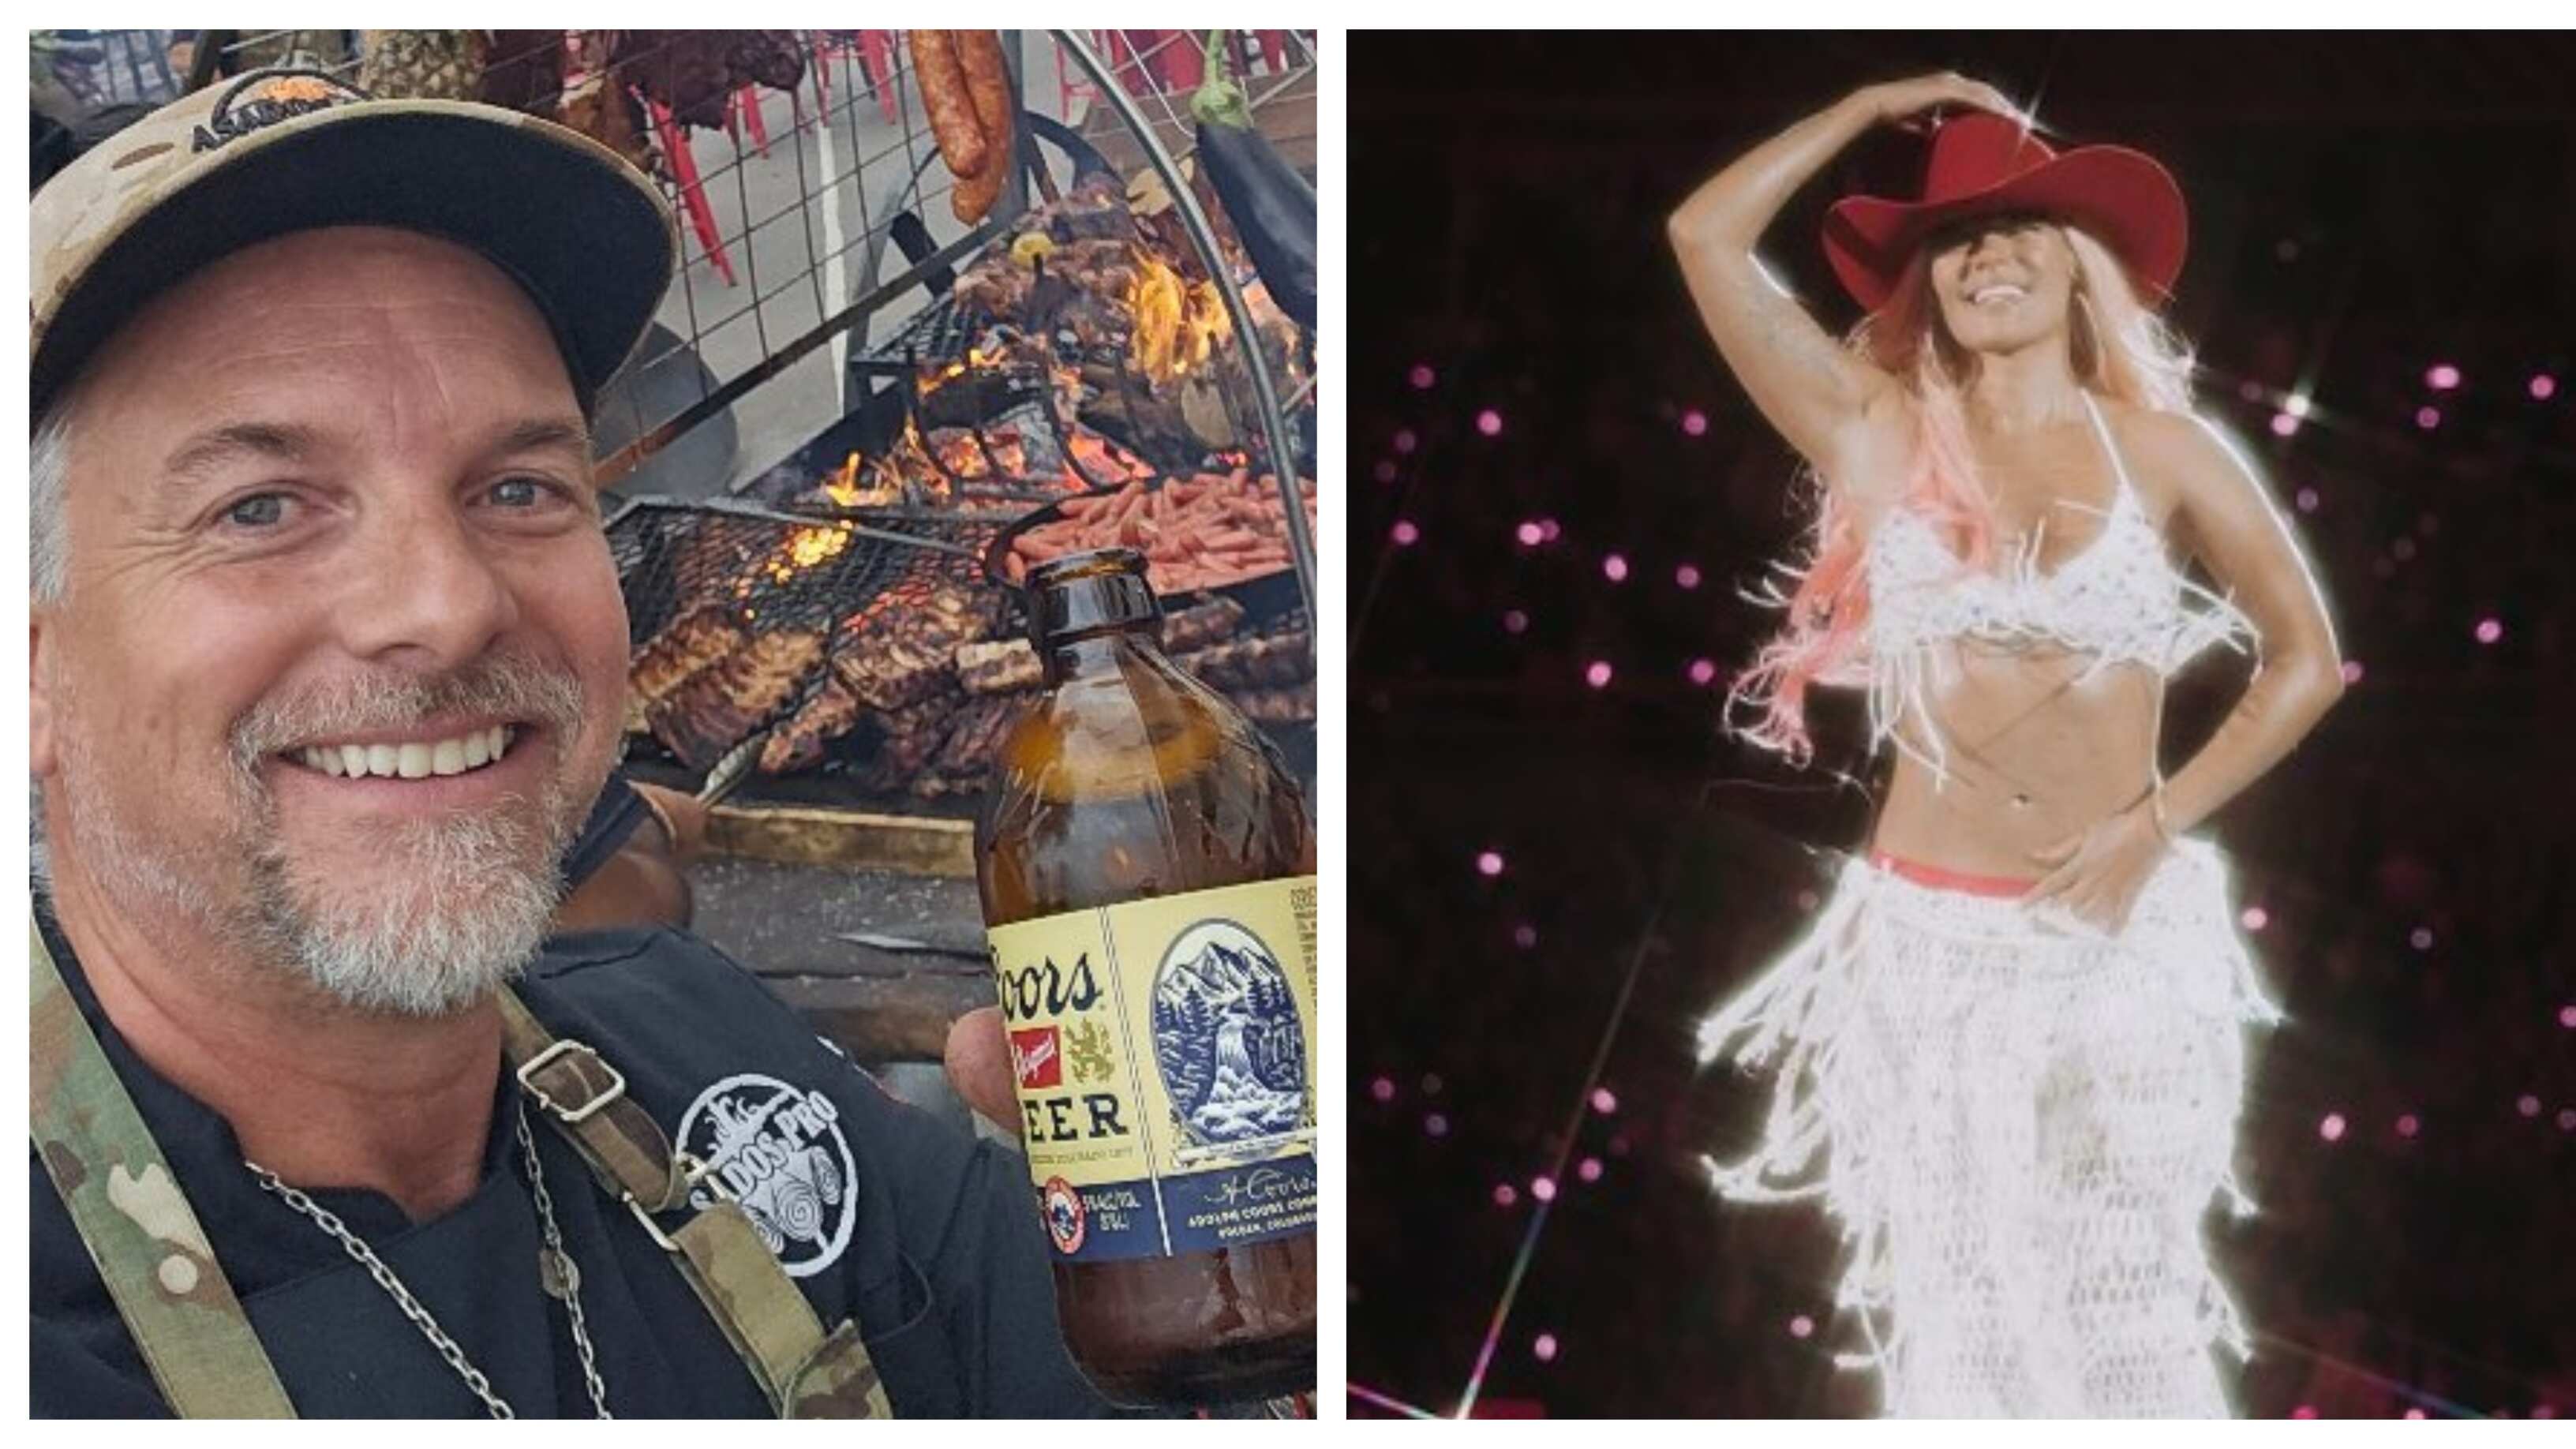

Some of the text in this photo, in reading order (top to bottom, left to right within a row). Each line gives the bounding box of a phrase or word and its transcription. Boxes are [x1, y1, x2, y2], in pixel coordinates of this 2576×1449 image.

[990, 944, 1103, 1021] oors
[721, 1090, 838, 1198] DOS PRO
[1023, 1093, 1129, 1143] EER
